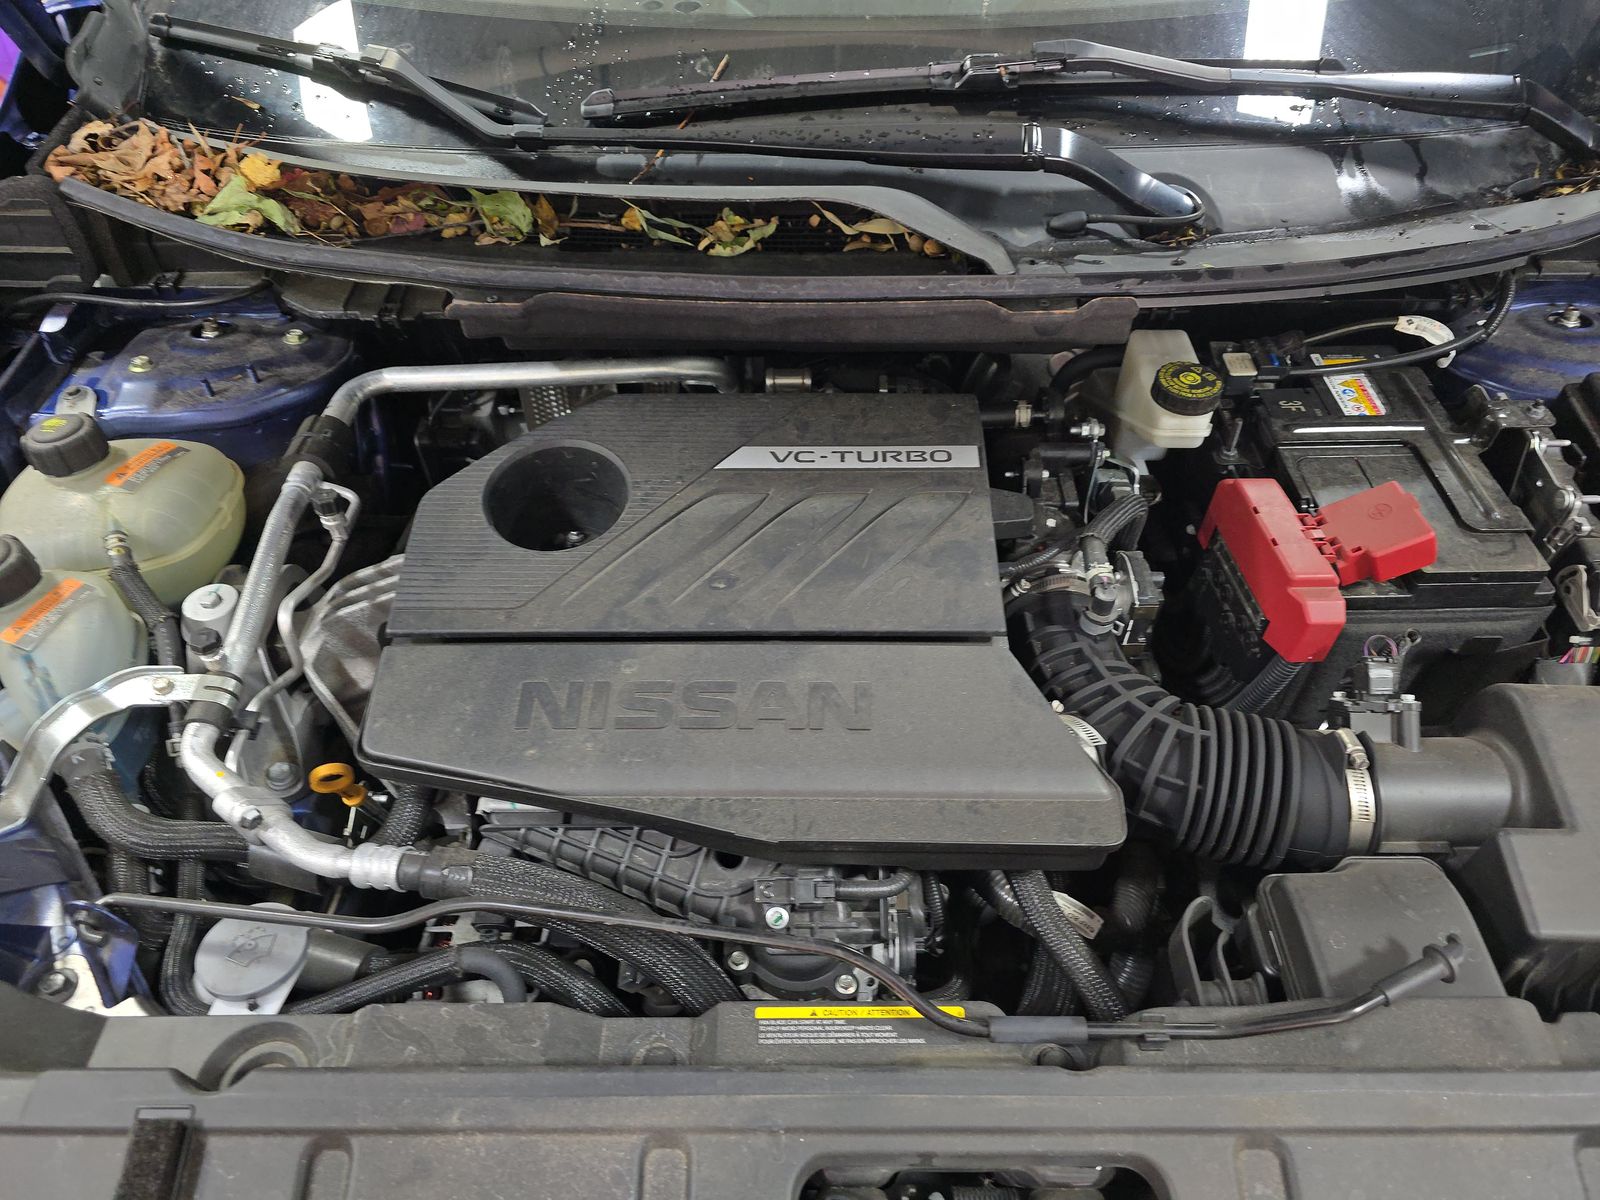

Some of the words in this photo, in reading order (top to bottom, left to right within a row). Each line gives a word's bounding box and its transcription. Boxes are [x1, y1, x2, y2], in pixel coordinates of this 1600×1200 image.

[769, 450, 953, 463] VC-TURBO
[514, 680, 873, 731] NISSAN
[822, 1009, 858, 1017] CAUTION
[867, 1009, 911, 1017] ATTENTION
